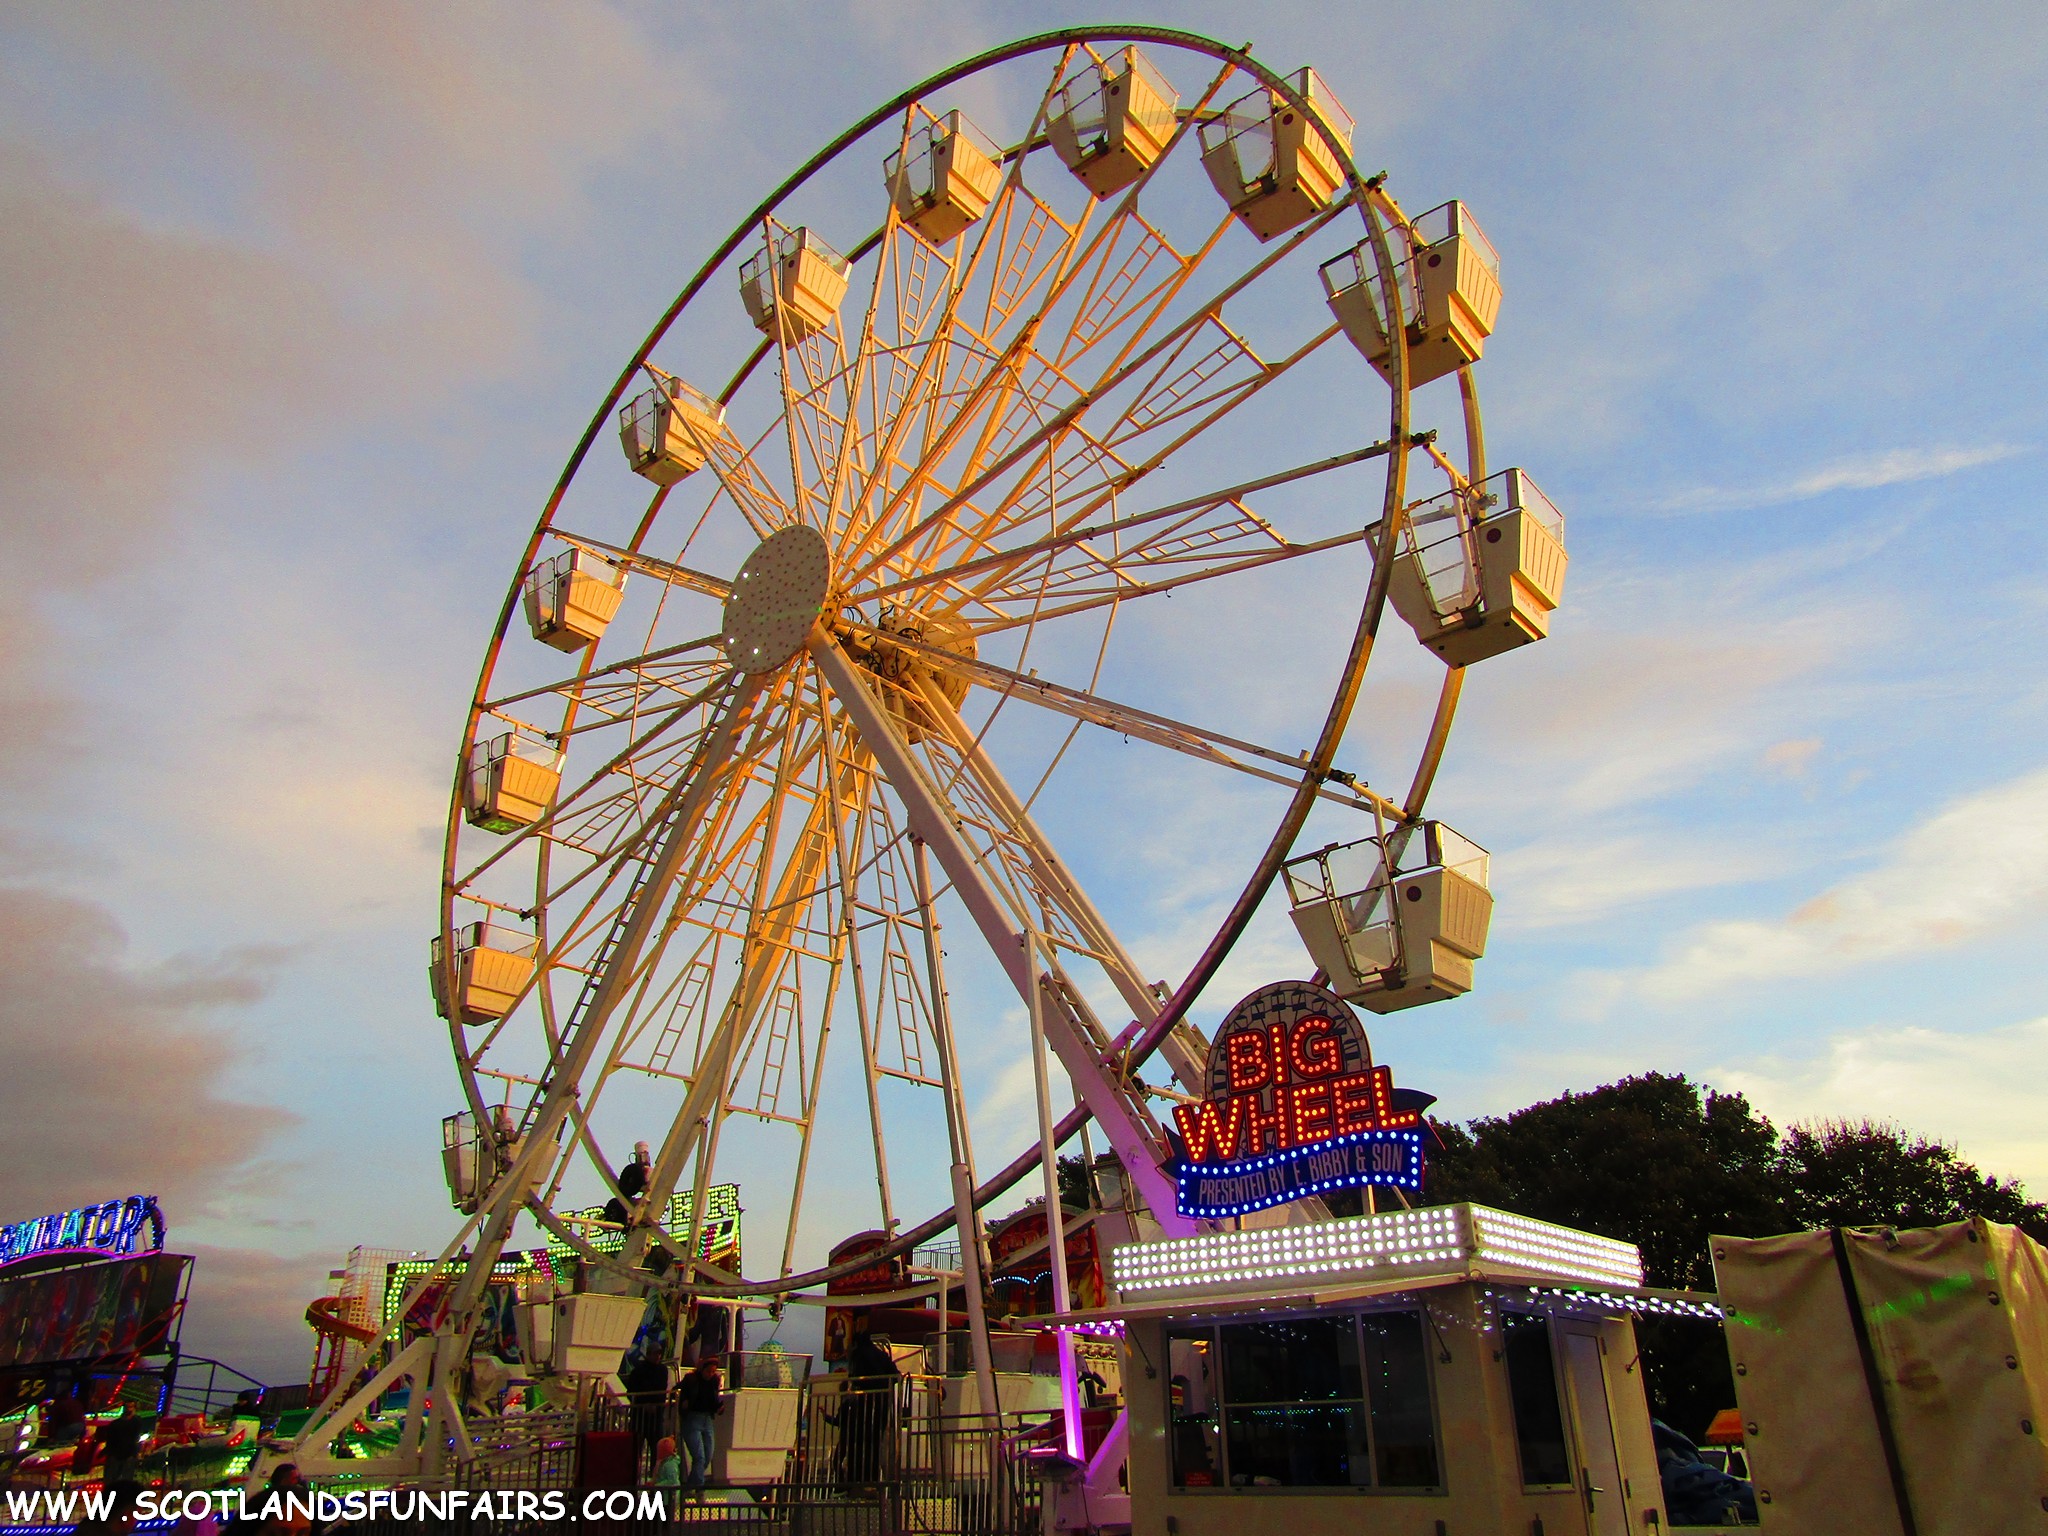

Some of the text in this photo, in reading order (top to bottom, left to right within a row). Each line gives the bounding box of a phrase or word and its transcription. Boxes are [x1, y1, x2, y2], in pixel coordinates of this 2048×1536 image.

[1226, 1014, 1343, 1093] BIG
[1172, 1065, 1418, 1163] WHEEL
[1199, 1176, 1266, 1206] PRESENTED
[1268, 1166, 1288, 1194] BY
[1308, 1148, 1350, 1183] BIBBY
[1356, 1145, 1366, 1173] &
[1372, 1142, 1403, 1173] SON
